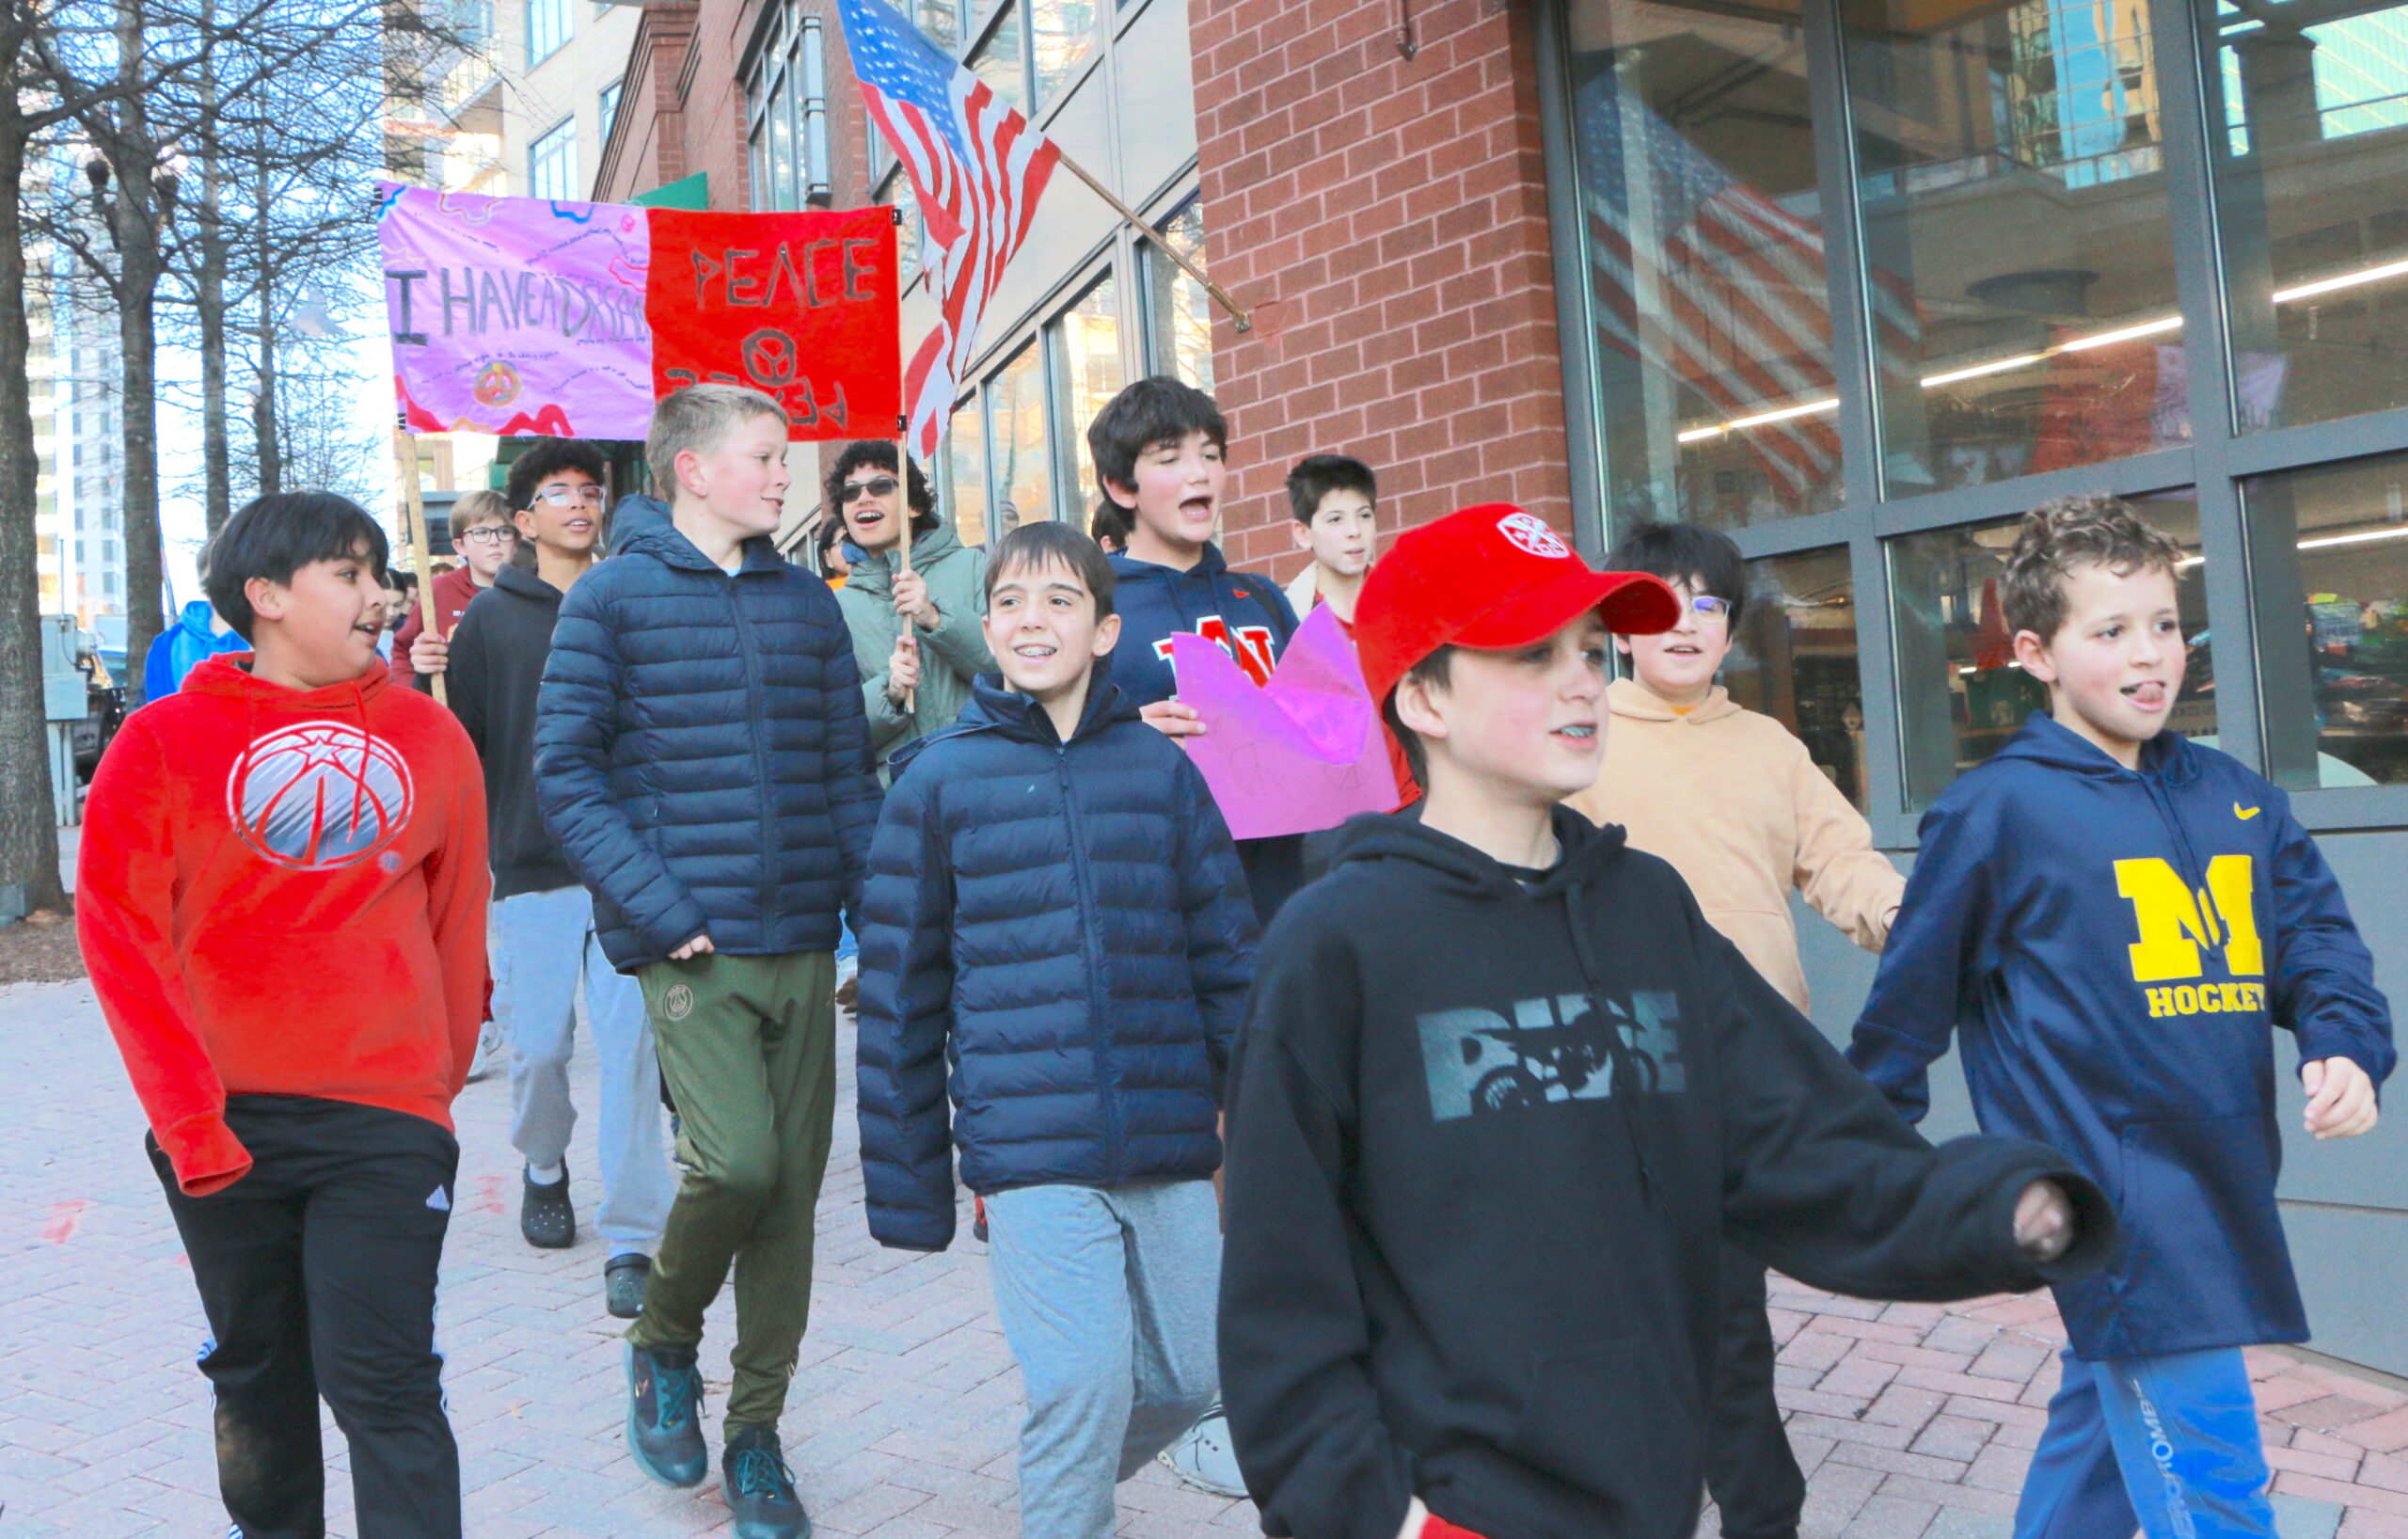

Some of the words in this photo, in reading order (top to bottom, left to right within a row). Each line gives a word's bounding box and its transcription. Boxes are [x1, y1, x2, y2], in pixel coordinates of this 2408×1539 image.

[385, 269, 428, 346] I
[690, 237, 880, 312] PEACE
[2113, 854, 2264, 982] M
